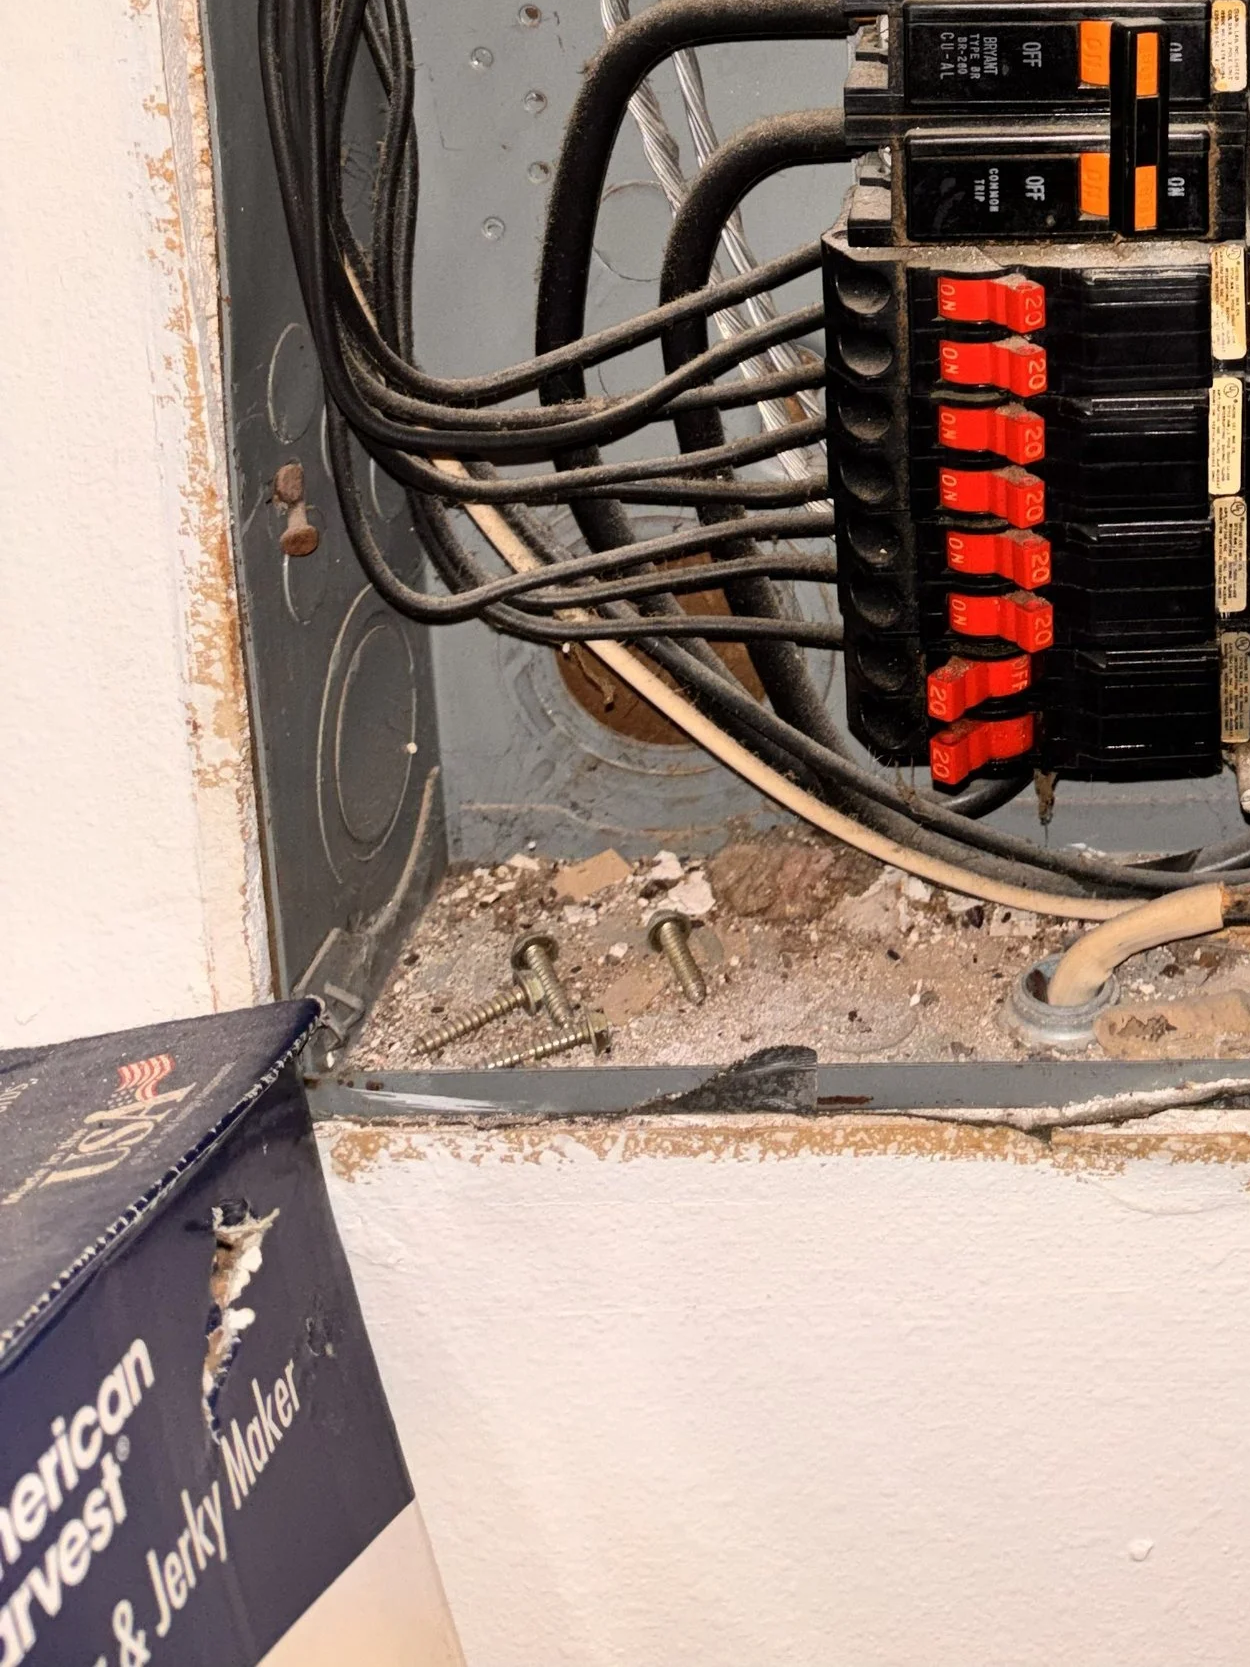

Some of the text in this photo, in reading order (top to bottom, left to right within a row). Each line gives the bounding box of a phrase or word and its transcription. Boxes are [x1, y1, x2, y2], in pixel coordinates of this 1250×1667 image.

[940, 32, 954, 80] CU-AL
[969, 34, 980, 60] TYPE
[983, 37, 998, 75] BRYANT
[1023, 42, 1042, 68] OFF
[1169, 42, 1183, 62] ON
[974, 179, 985, 202] TRIP
[989, 168, 999, 212] COMMON
[1025, 176, 1045, 201] OFF
[1168, 177, 1185, 197] ON
[941, 285, 956, 311] ON
[1025, 295, 1043, 326] 20
[943, 347, 959, 375] ON
[1029, 358, 1046, 390] 20
[941, 412, 956, 440] ON
[1025, 426, 1043, 458] 20
[942, 474, 957, 501] ON
[1026, 490, 1044, 522] 20
[949, 537, 964, 564] ON
[1032, 552, 1050, 582] 20
[952, 599, 967, 626] ON
[1035, 614, 1051, 645] 20
[1012, 655, 1028, 690] OFF
[930, 685, 946, 715] 20
[933, 748, 949, 778] 20
[39, 1082, 197, 1188] USA
[112, 1358, 300, 1667] & Jerky Maker
